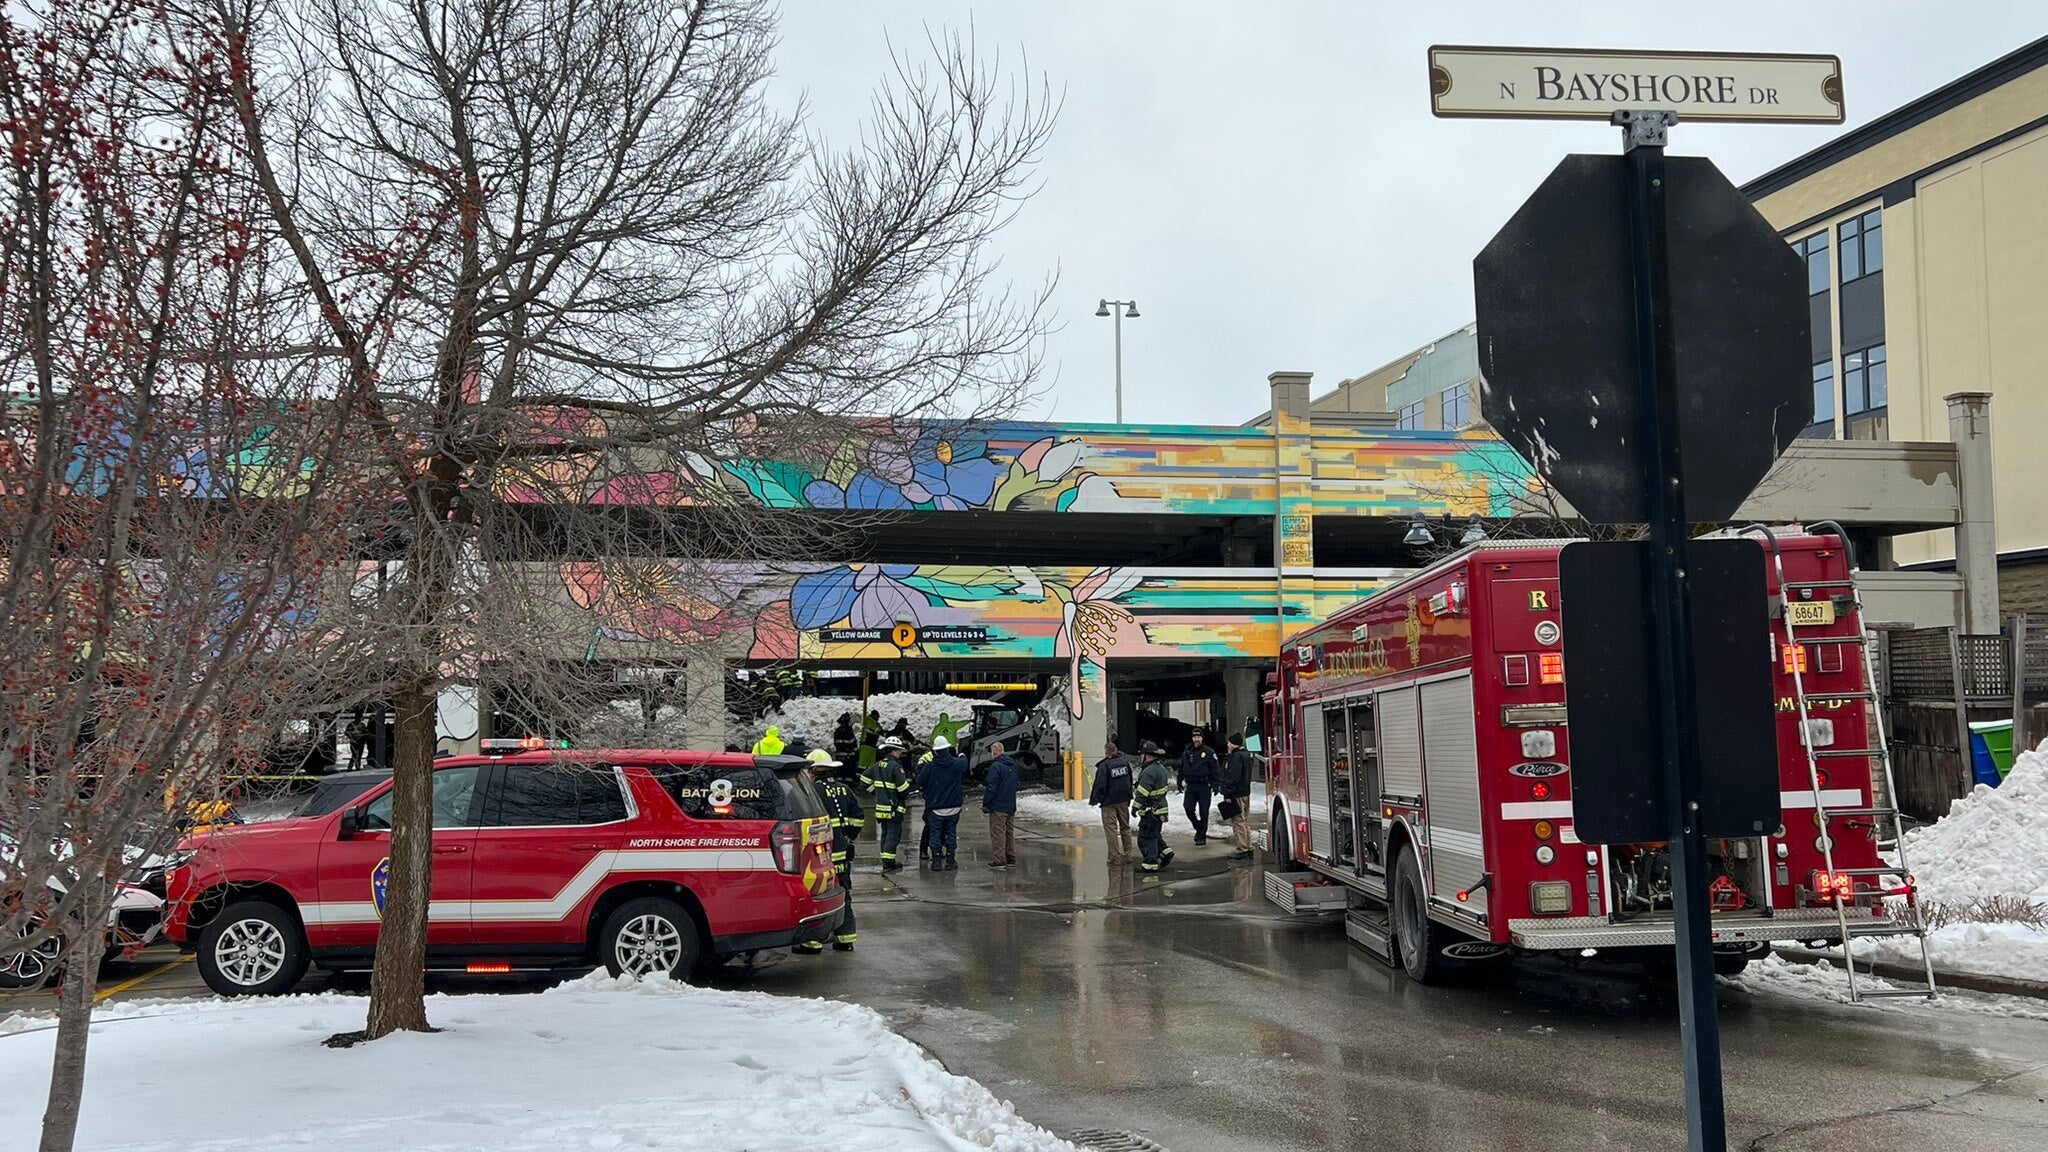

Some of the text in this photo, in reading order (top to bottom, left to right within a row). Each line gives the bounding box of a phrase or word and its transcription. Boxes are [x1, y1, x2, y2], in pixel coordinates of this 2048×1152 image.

[1500, 66, 1780, 104] N BAYSHORE DR
[1795, 606, 1823, 619] 68647
[831, 631, 855, 639] YELLOW
[857, 631, 881, 639] GARAGE
[901, 629, 909, 641] P
[922, 631, 931, 639] UP
[932, 631, 939, 639] TO
[940, 631, 962, 639] LEVELS
[963, 631, 968, 639] 2
[973, 631, 978, 639] 3
[1522, 764, 1556, 775] Pierce
[681, 788, 760, 798] BATTALION
[708, 779, 733, 806] 8
[629, 838, 761, 848] NORTH SHORE FIRE/RESCUE
[1454, 944, 1499, 955] Pierce
